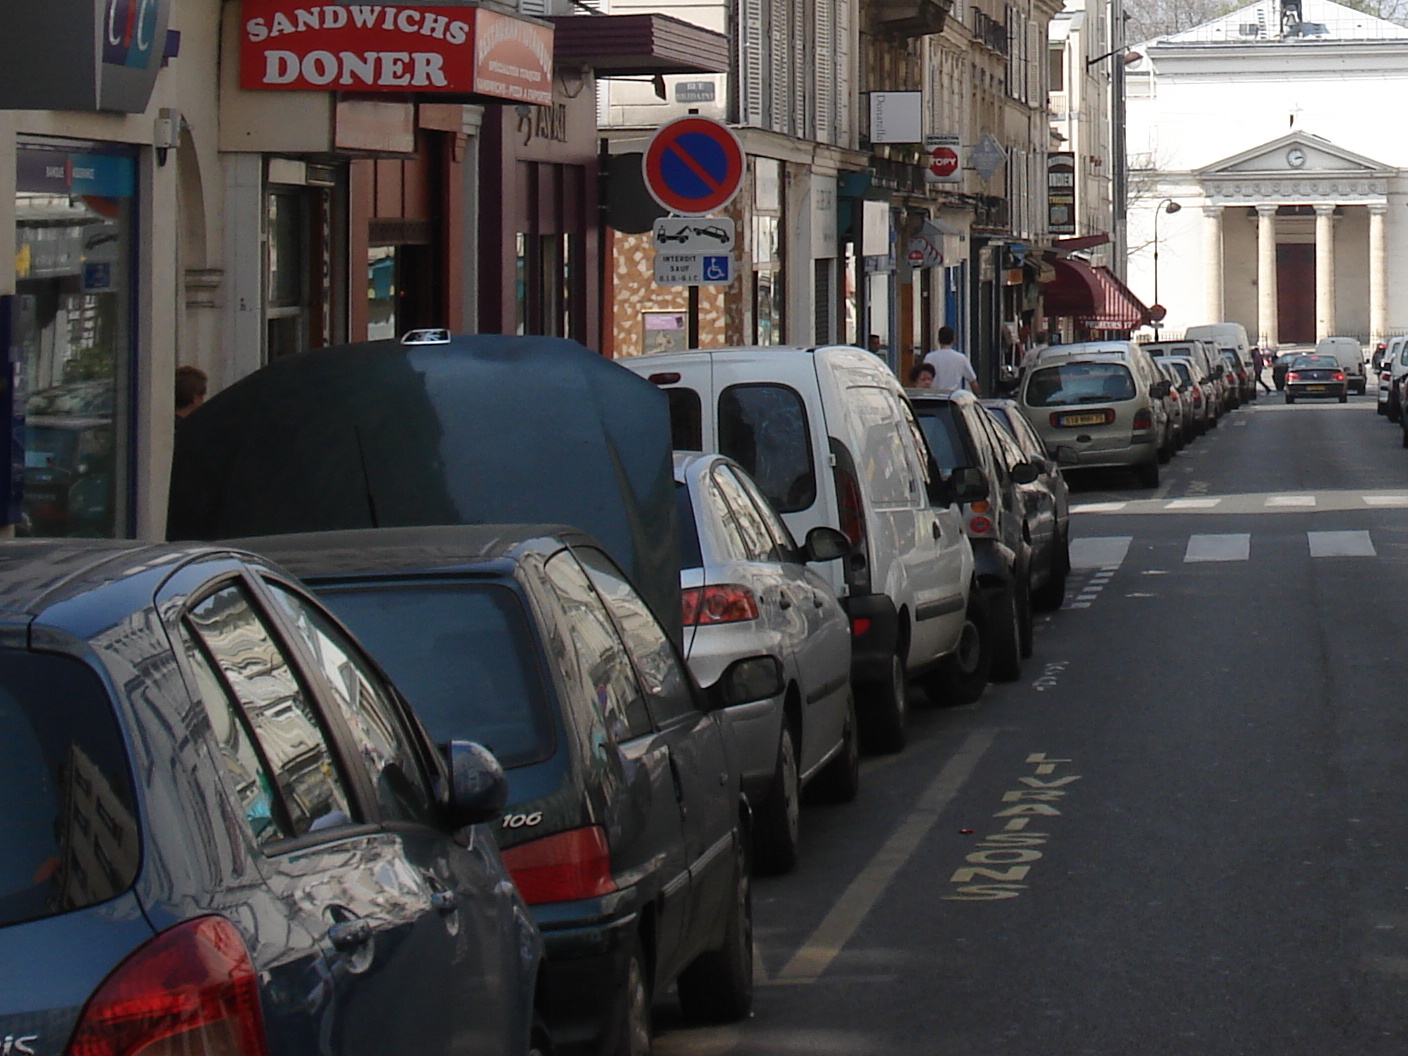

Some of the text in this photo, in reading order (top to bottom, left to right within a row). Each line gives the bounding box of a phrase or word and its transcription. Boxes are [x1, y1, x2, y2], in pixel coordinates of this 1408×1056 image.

[246, 6, 469, 45] SANDWICHS
[262, 50, 448, 86] DONER
[930, 157, 957, 167] TOPY
[502, 811, 542, 828] 106
[940, 752, 1082, 901] LIVRAISONS
